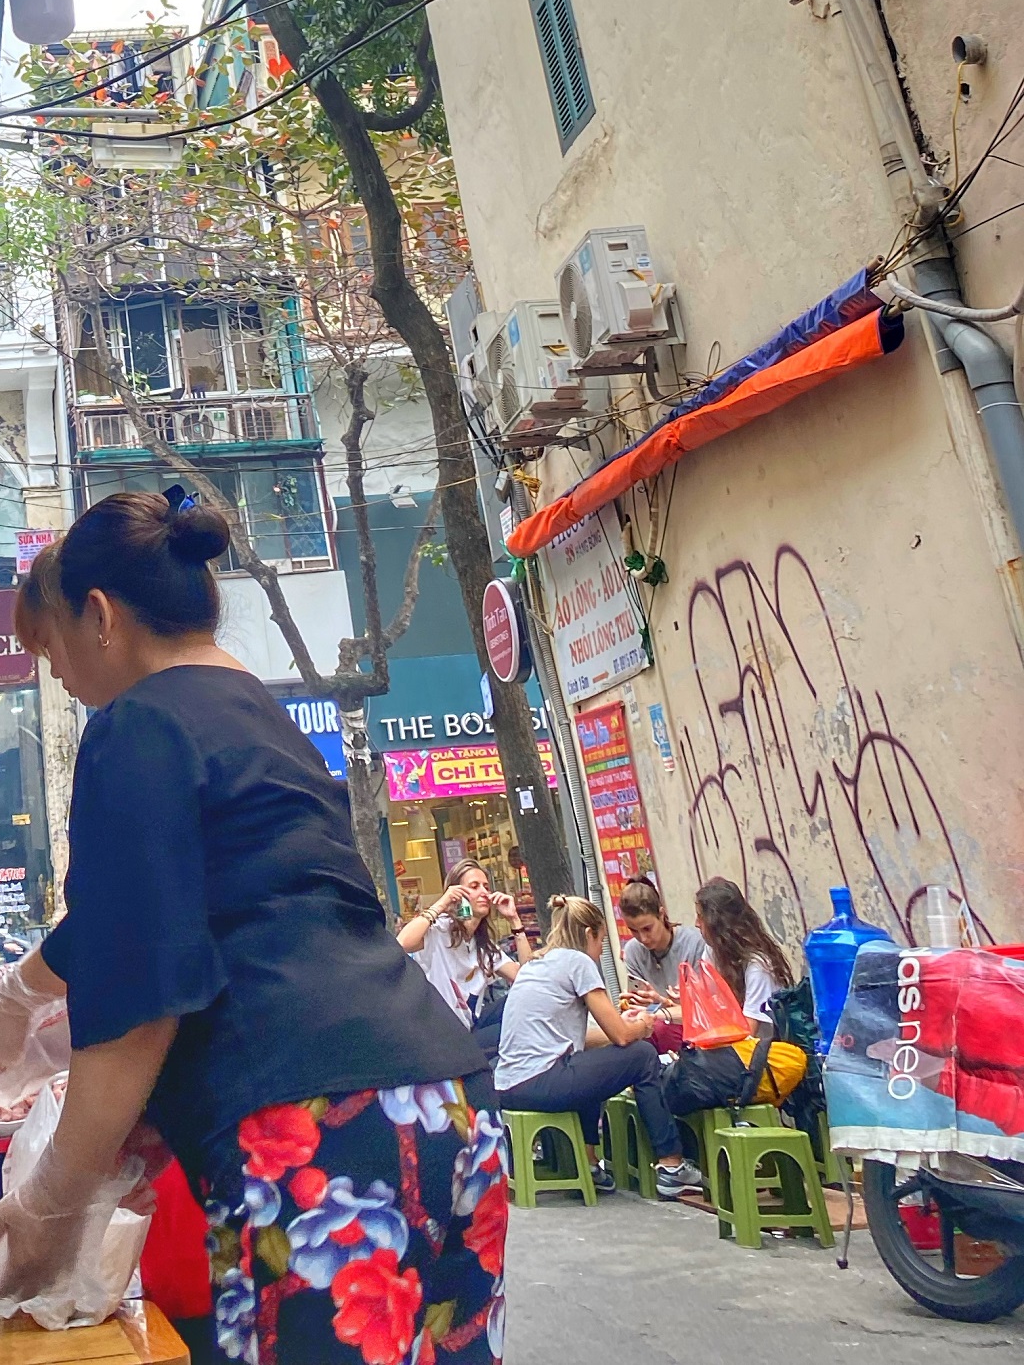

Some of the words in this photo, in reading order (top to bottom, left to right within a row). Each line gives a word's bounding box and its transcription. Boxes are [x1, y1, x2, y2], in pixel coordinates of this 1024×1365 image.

[286, 701, 339, 734] TOUR
[381, 715, 435, 741] THE
[438, 764, 475, 781] CHỈ
[888, 1021, 921, 1101] neo
